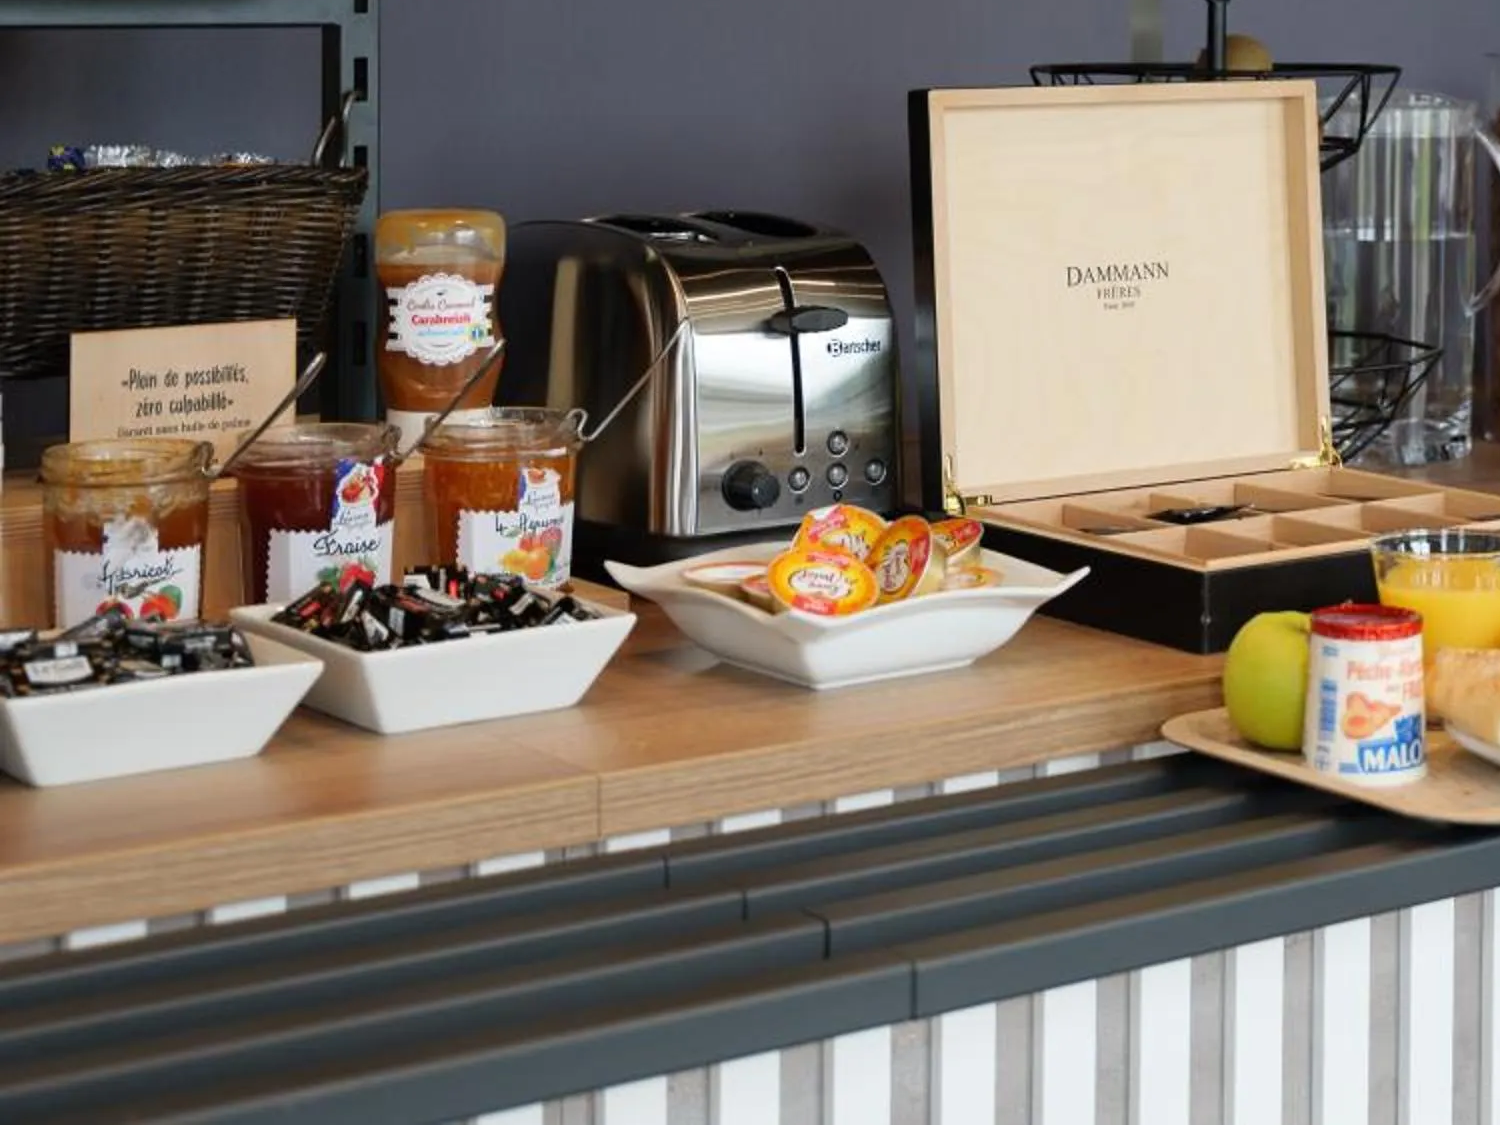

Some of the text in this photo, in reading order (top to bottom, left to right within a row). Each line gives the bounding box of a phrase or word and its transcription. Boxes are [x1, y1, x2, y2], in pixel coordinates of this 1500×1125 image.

[1066, 261, 1169, 287] DAMMANN
[164, 369, 178, 387] de
[1363, 740, 1422, 772] MALO
